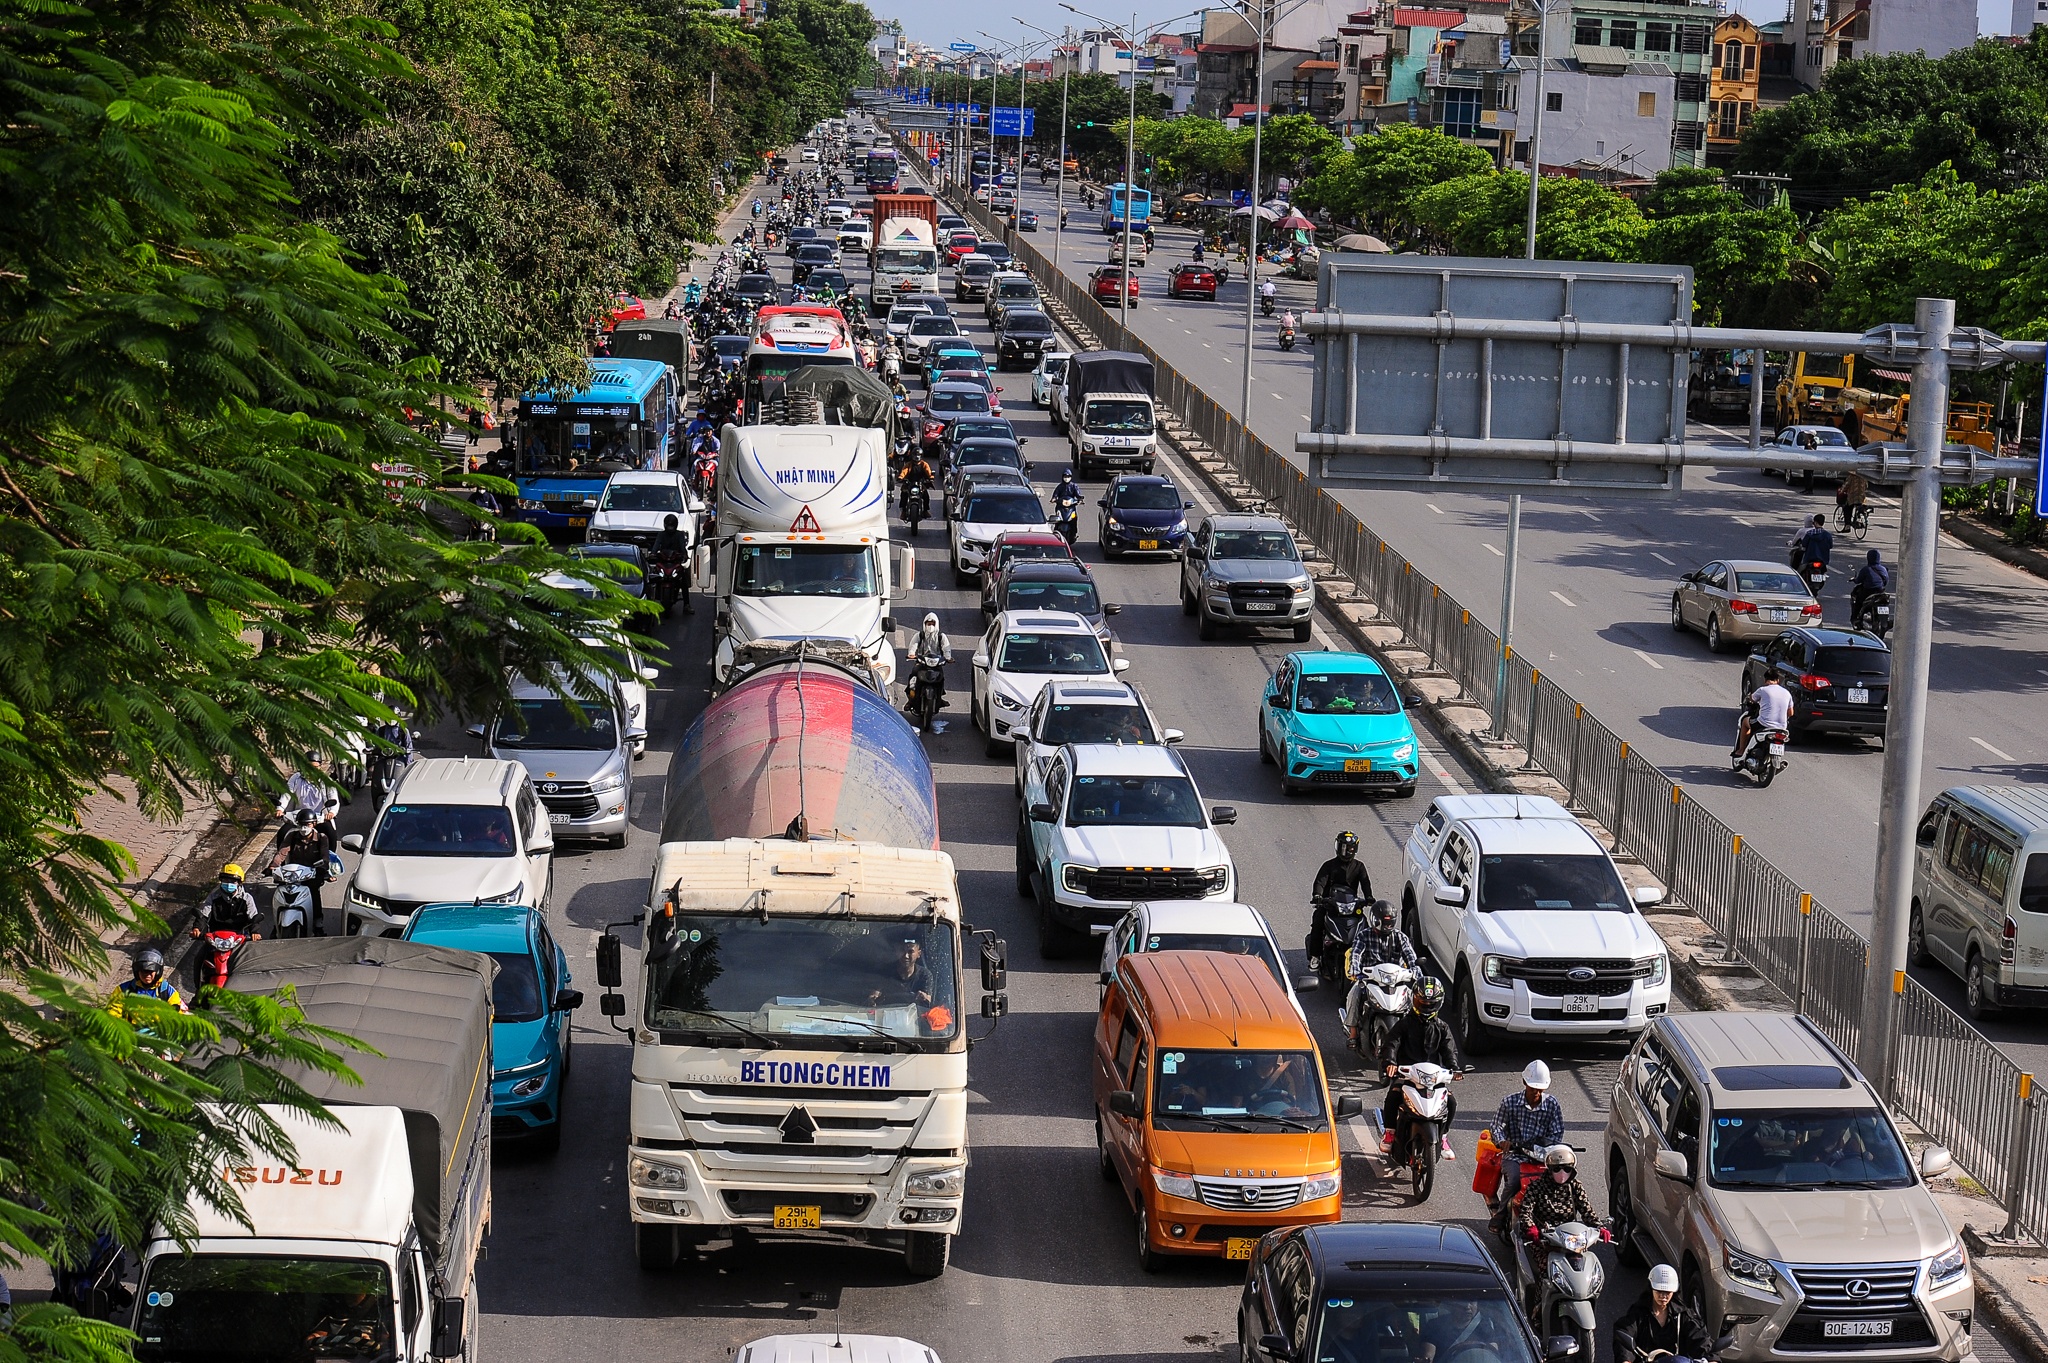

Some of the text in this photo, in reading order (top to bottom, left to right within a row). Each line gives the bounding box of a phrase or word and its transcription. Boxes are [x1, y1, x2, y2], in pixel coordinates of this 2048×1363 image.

[638, 333, 652, 341] 24h
[776, 466, 836, 486] NHẬT MINH
[1566, 1004, 1595, 1012] 086.17
[741, 1060, 891, 1088] BETONGCHEM
[222, 1166, 343, 1186] ISUZU
[787, 1206, 807, 1217] 29H
[779, 1217, 815, 1229] 831.94
